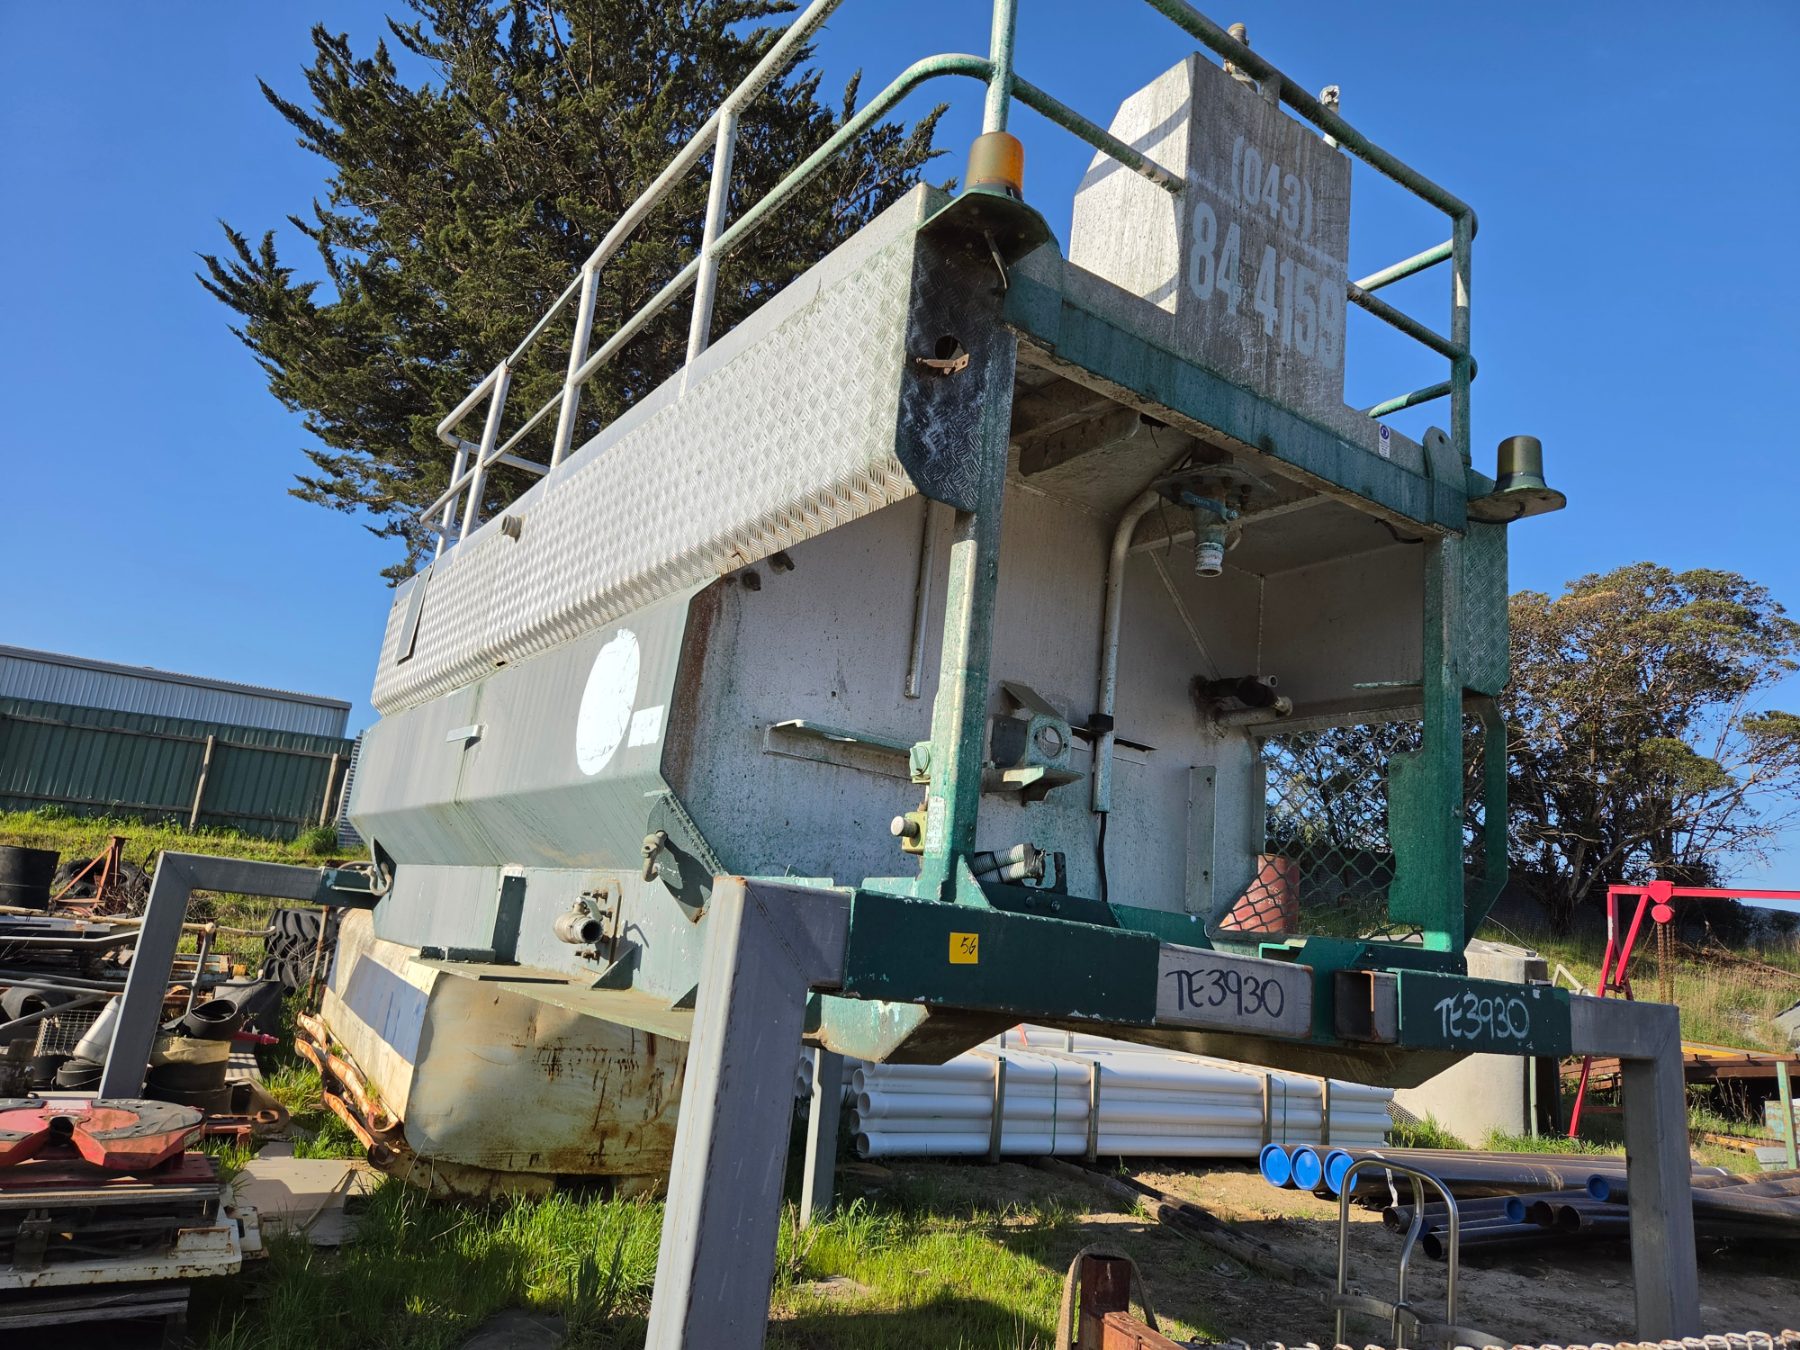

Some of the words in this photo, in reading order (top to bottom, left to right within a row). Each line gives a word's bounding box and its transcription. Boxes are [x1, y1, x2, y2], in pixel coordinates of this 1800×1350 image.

[1231, 135, 1313, 243] (043)
[1190, 202, 1242, 316] 84
[960, 936, 977, 955] 56
[1165, 969, 1285, 1018] TE3930
[1434, 992, 1530, 1040] TE3930
